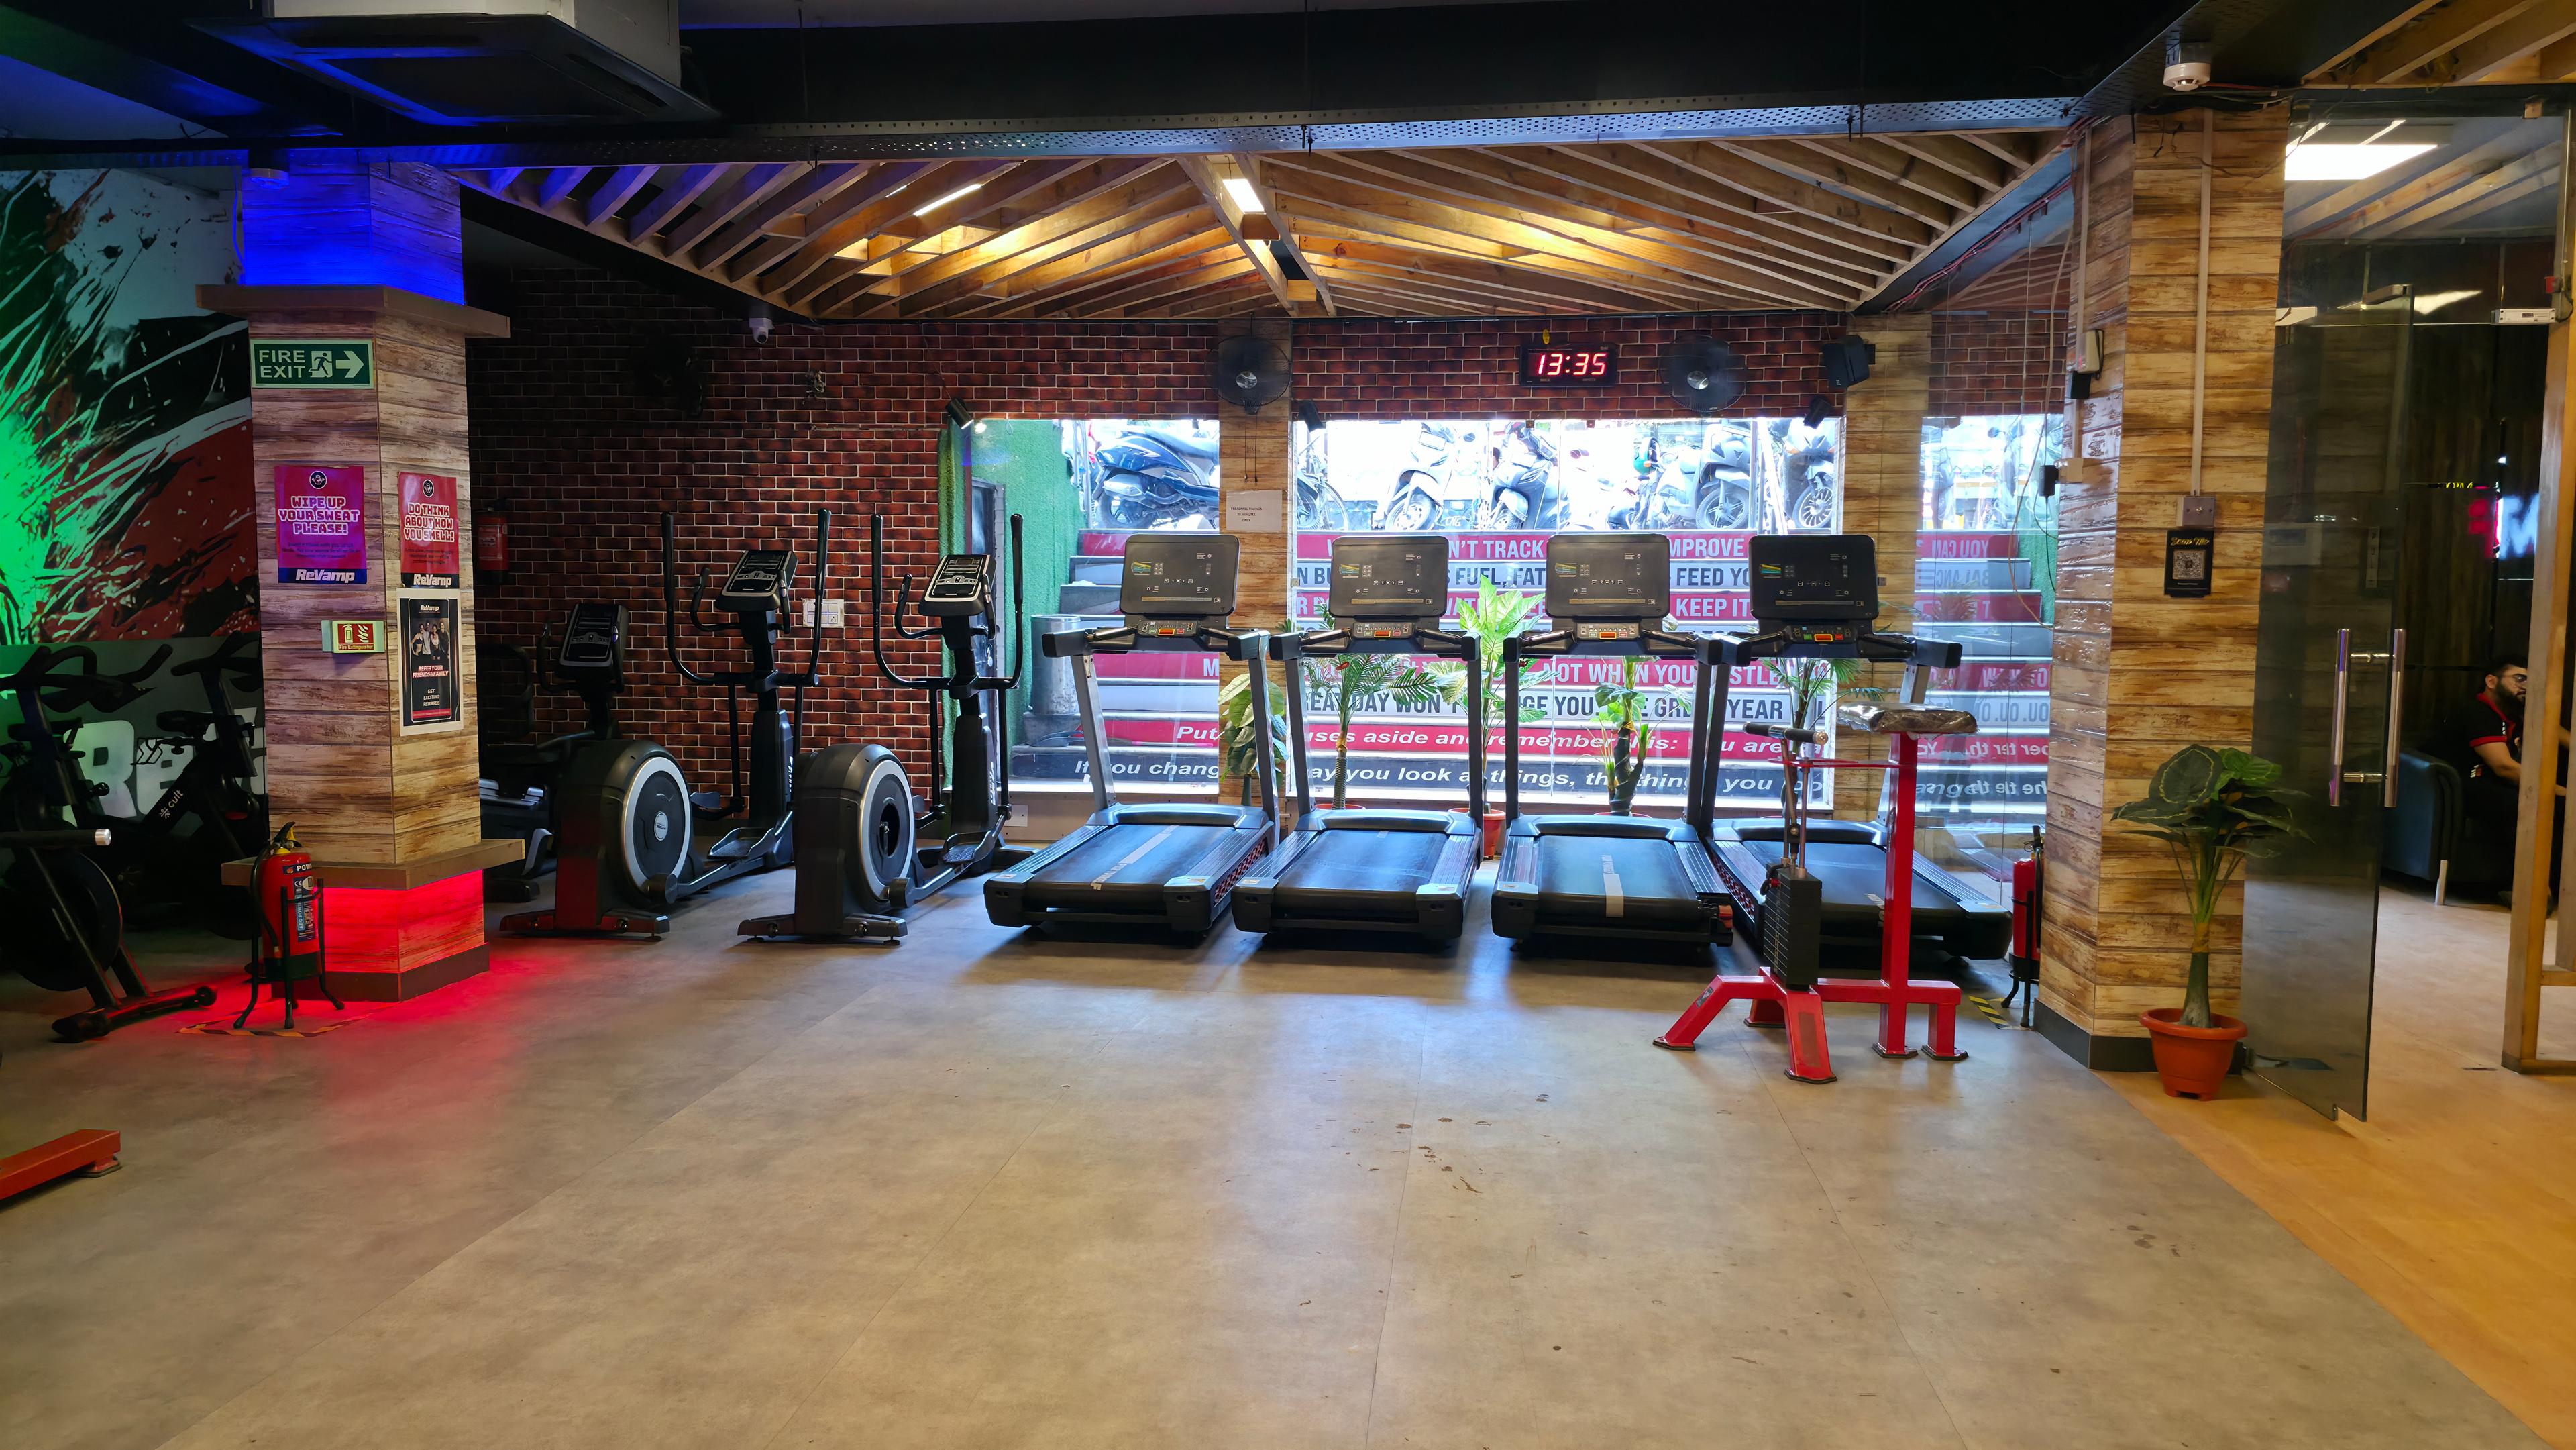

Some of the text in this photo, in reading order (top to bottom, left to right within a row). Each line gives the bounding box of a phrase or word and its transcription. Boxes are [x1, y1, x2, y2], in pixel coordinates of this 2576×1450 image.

[259, 350, 305, 363] FIRE
[1538, 353, 1607, 375] 13:35
[260, 365, 305, 378] EXIT
[291, 496, 346, 509] WIPE UP
[407, 502, 450, 517] DO THINK
[278, 509, 360, 522] YOUR SWEAT
[405, 515, 453, 530] ABOUT HOW
[293, 522, 349, 535] PLEASE!
[403, 527, 455, 543] YOU SMELL!
[1448, 538, 1743, 558] N'T TRACK MPROVE
[295, 569, 355, 583] ReVamp
[413, 574, 452, 588] ReVamp
[1513, 568, 1546, 586] FAT
[1676, 568, 1724, 586] FEED
[1676, 598, 1727, 617] KEEP
[1352, 692, 1390, 712] DAY
[1727, 699, 1783, 719] YEAR
[1177, 726, 1218, 741] Put
[1364, 730, 1428, 744] aside
[1435, 735, 1469, 745] an
[1743, 741, 1782, 753] are
[1111, 764, 1141, 774] ou
[1149, 761, 1219, 779] chang
[1344, 769, 1390, 782] you
[1398, 767, 1454, 782] look
[1723, 778, 1773, 792] you
[168, 789, 184, 808] cult
